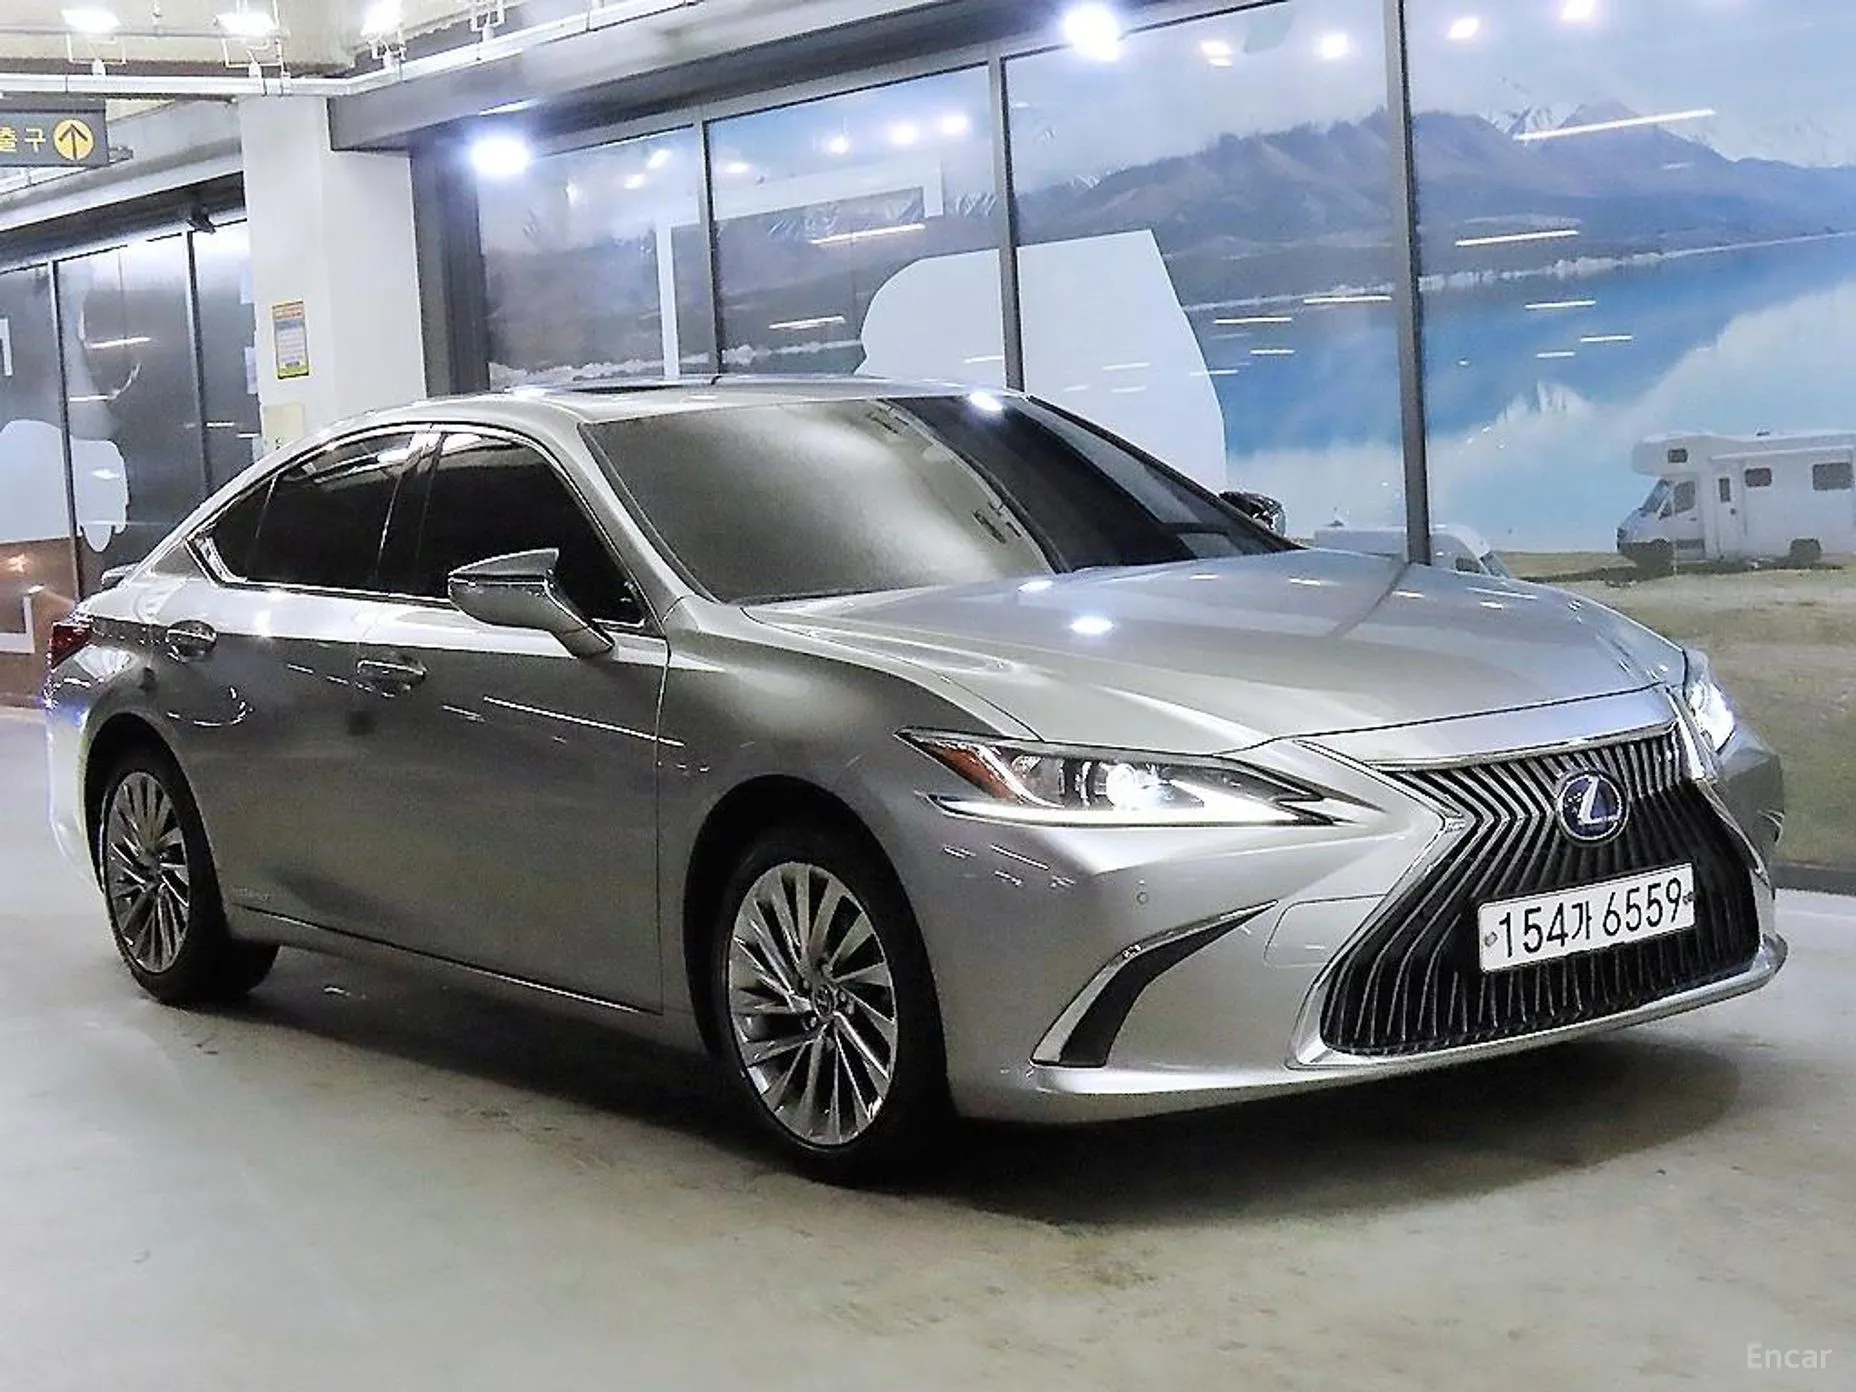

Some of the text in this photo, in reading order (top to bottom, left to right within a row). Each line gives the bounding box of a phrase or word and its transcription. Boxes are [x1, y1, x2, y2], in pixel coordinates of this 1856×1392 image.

[0, 127, 46, 153] 출구
[1499, 877, 1682, 958] 154가 6559
